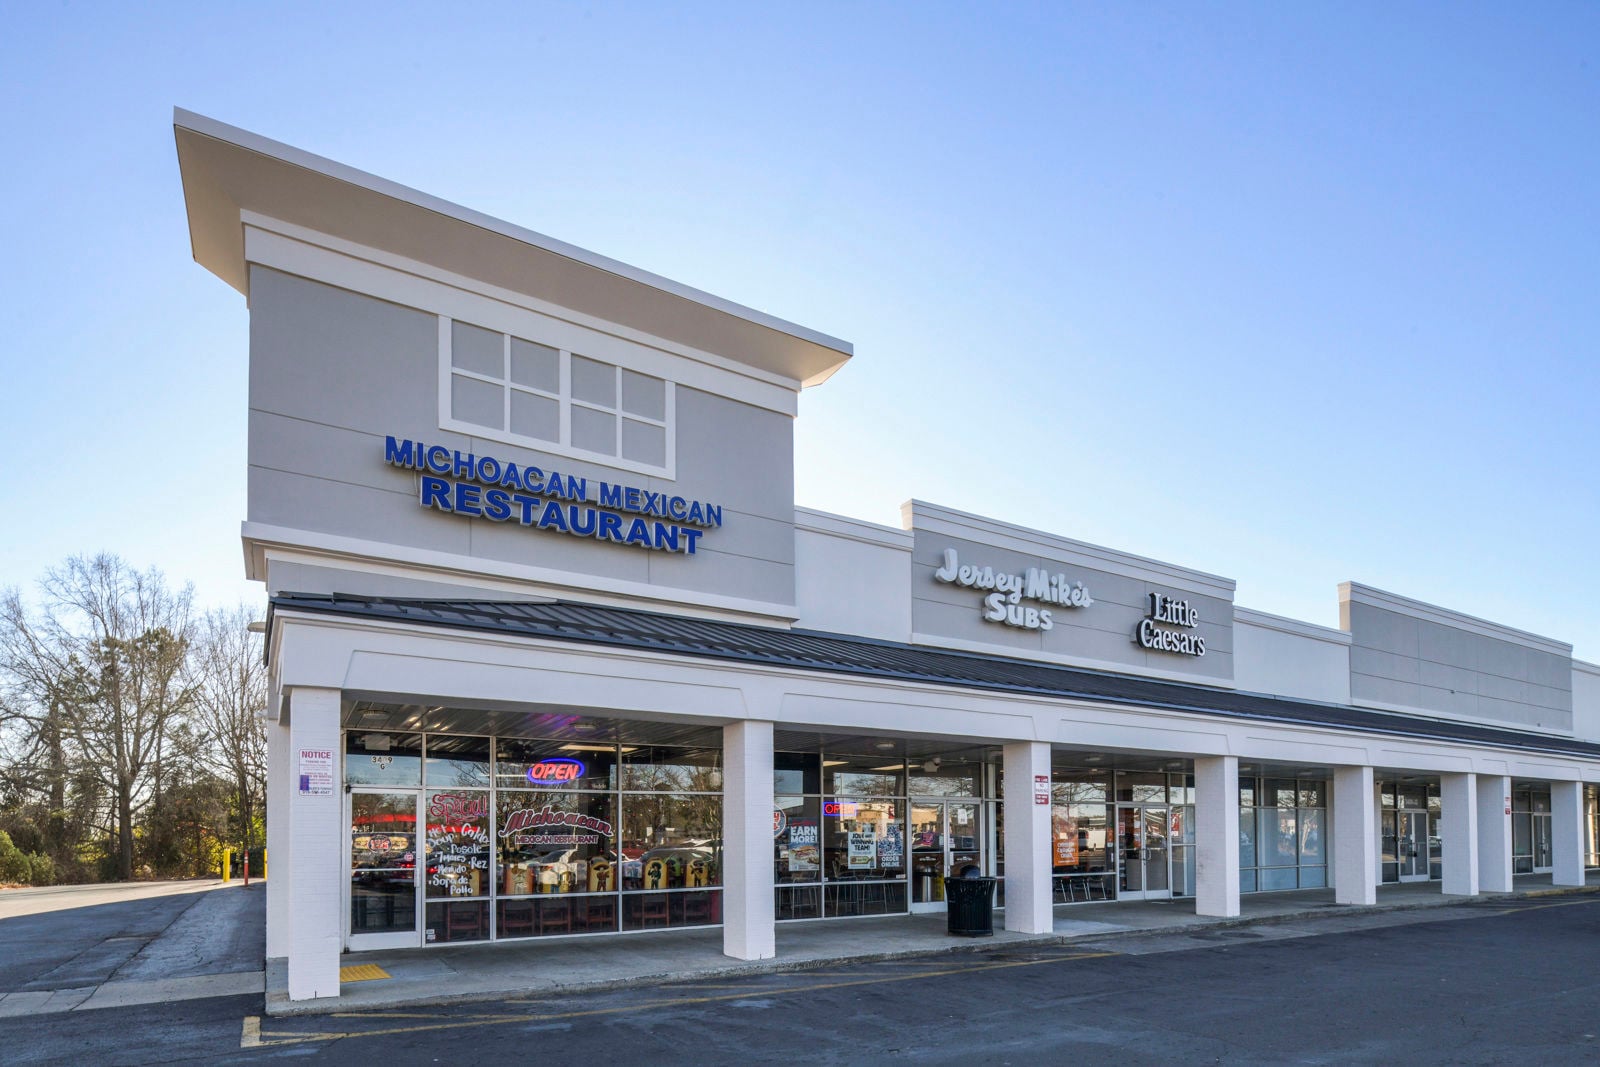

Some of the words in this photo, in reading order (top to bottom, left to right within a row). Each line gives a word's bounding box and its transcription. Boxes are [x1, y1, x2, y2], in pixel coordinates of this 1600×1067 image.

[384, 435, 587, 501] MICHOACAN
[598, 481, 723, 527] MEXICAN
[420, 475, 703, 554] RESTAURANT
[934, 548, 1022, 604] Jersey
[1025, 567, 1094, 608] Mike's
[1145, 592, 1199, 628] Little
[1137, 618, 1207, 657] Caesars
[301, 751, 331, 759] NOTICE
[531, 763, 579, 780] OPEN
[498, 805, 614, 837] Michoacan
[790, 825, 818, 836] EARN
[515, 835, 552, 844] MEXICAN
[553, 835, 599, 844] RESTAURANT
